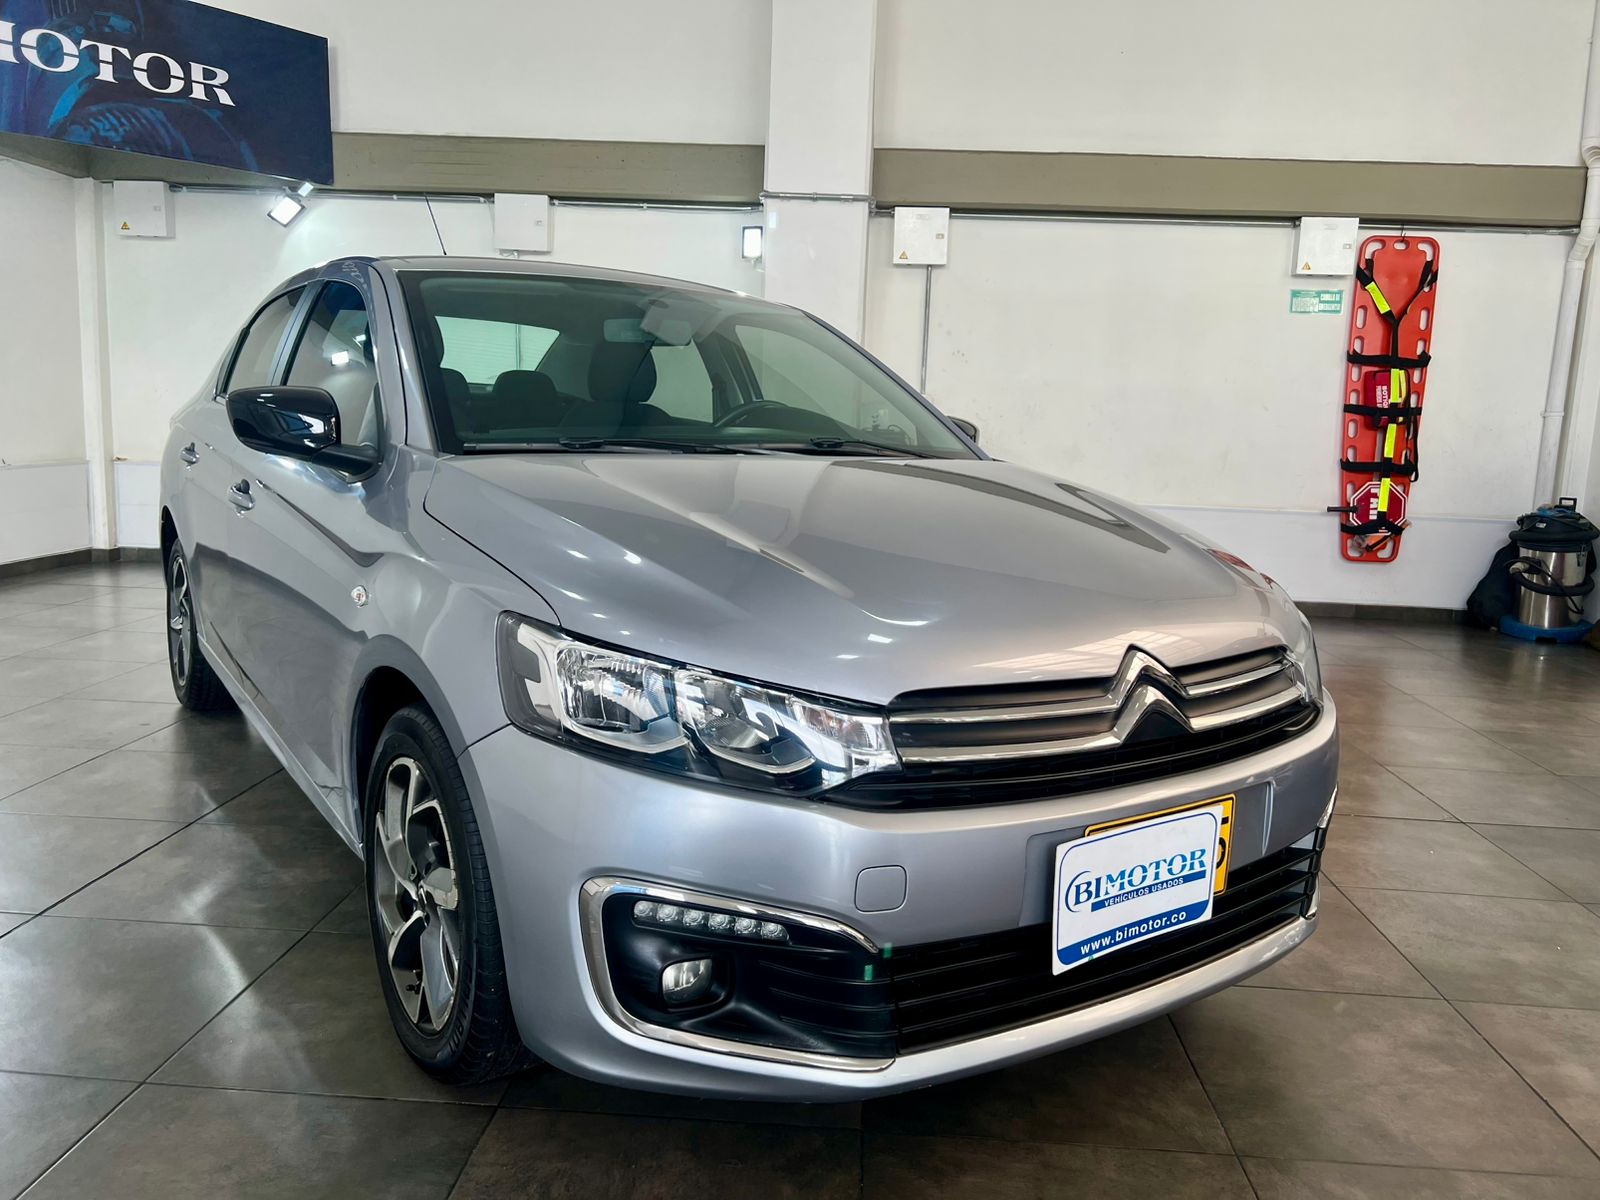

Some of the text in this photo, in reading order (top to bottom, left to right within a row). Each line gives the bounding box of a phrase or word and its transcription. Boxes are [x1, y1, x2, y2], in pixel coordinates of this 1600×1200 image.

[0, 20, 236, 107] OTOR
[1073, 848, 1207, 906] BIMOTOR
[1104, 877, 1184, 907] VEHÍCULOS USADOS
[1080, 911, 1187, 955] www.bimotor.co
